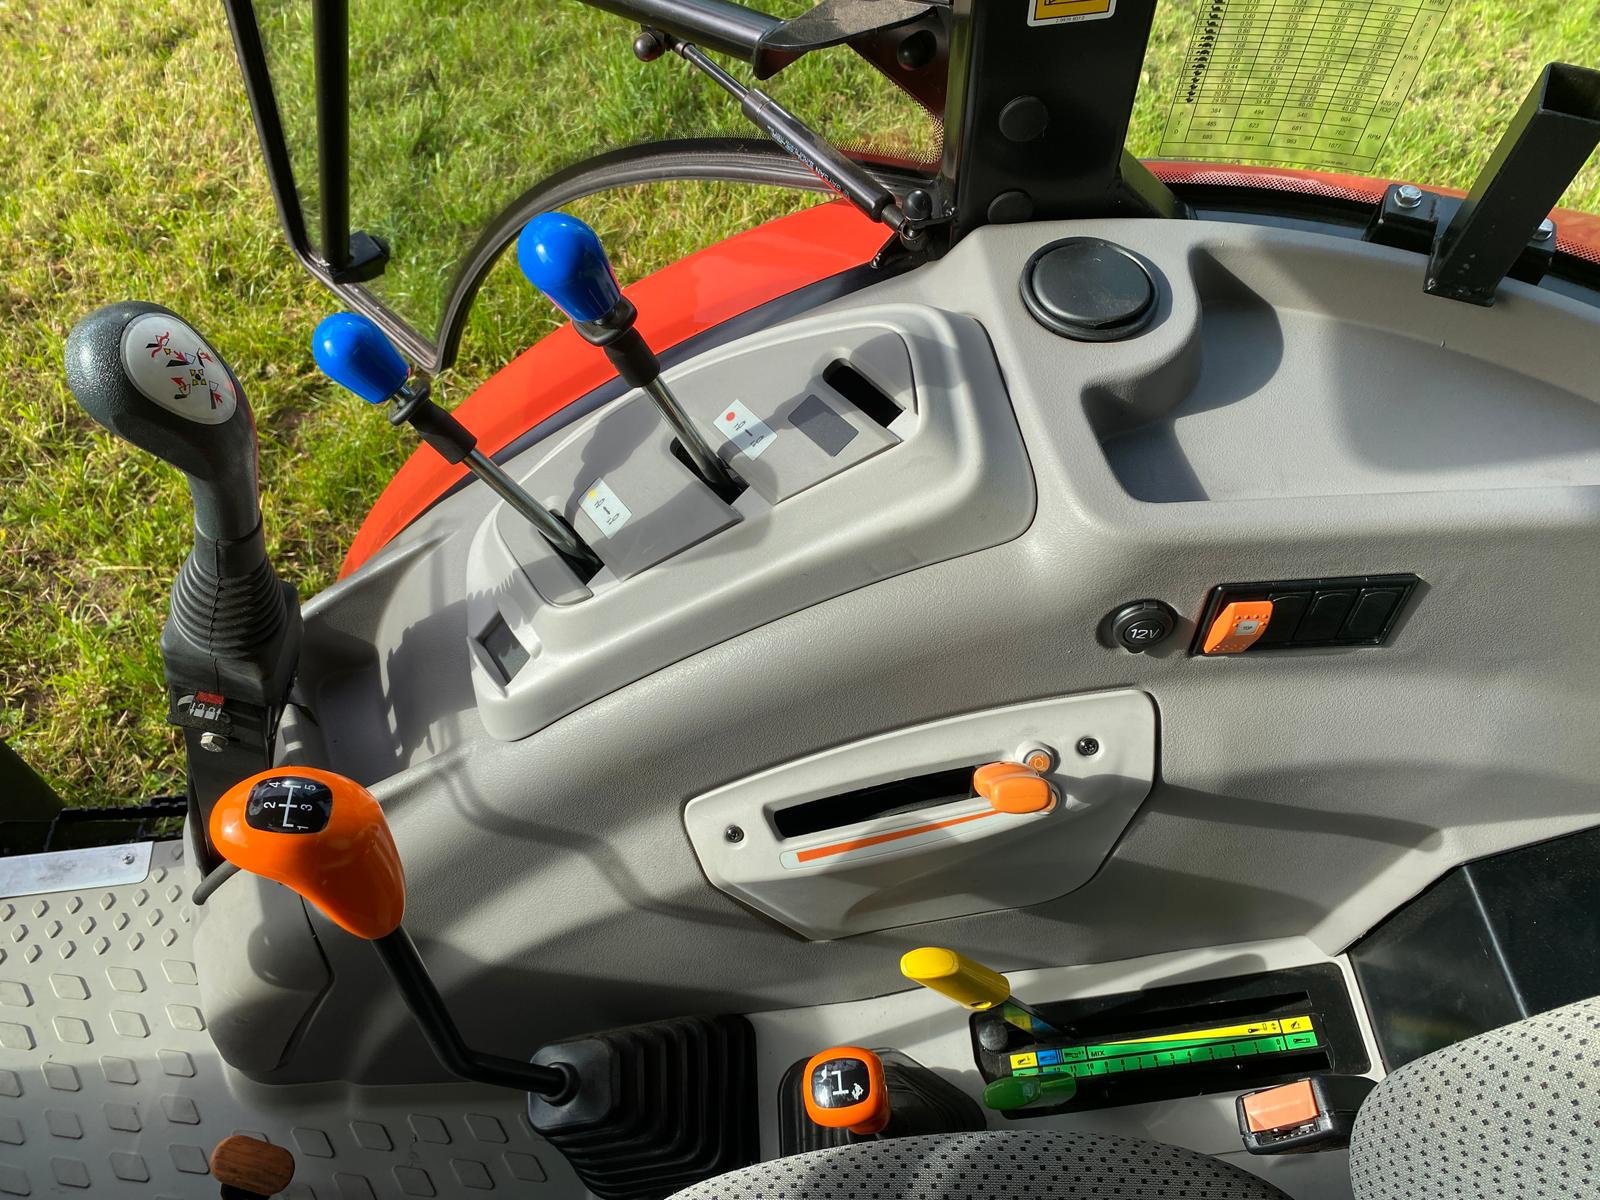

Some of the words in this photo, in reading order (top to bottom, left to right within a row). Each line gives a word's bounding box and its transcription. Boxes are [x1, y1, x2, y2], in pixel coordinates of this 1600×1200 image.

[1131, 628, 1160, 639] 12V
[263, 801, 276, 809] 2
[300, 803, 313, 811] 3
